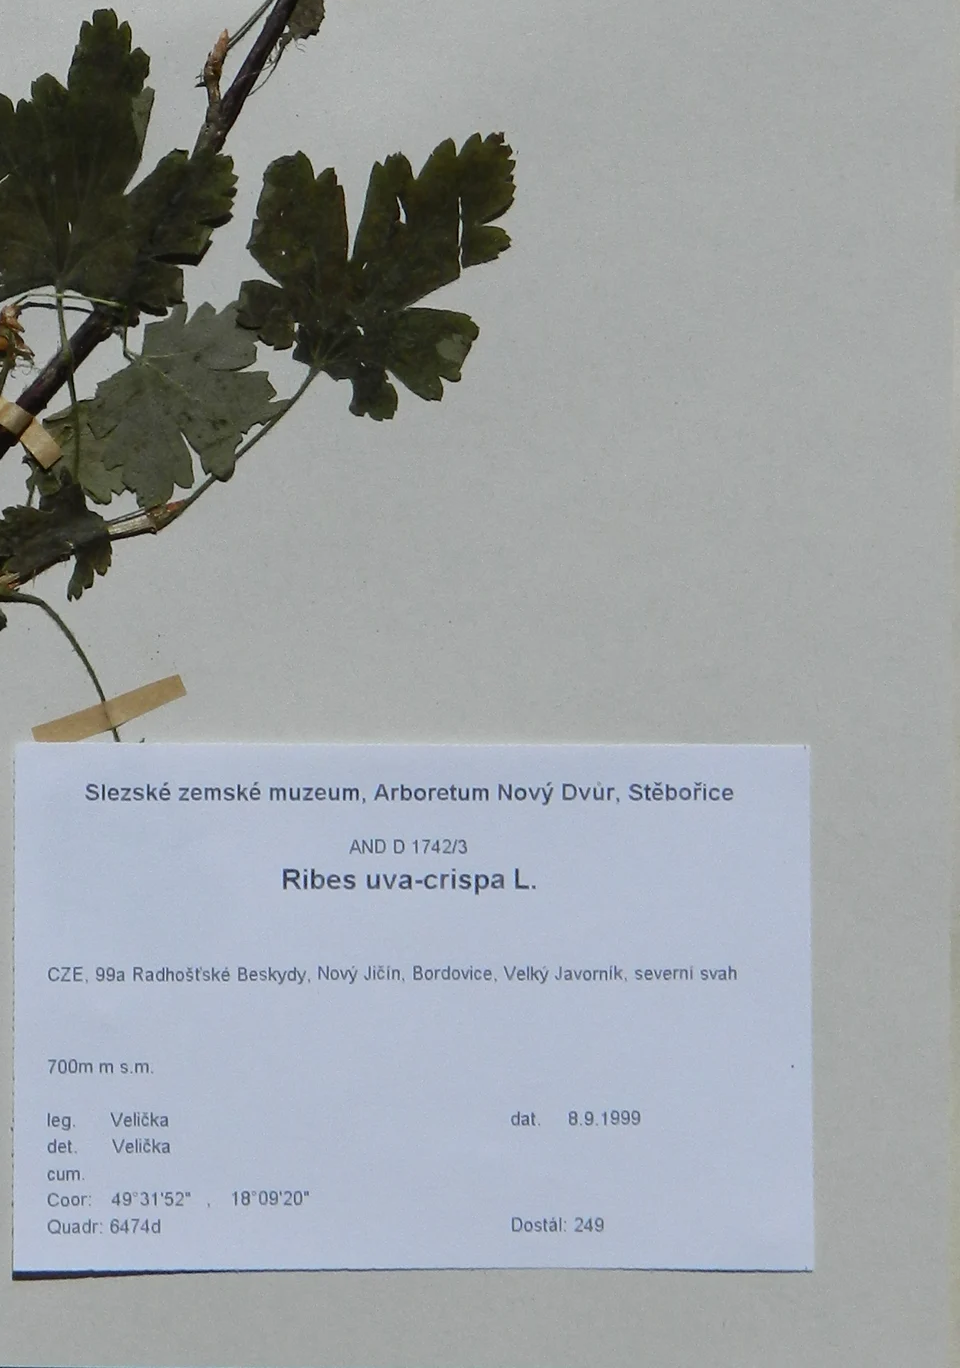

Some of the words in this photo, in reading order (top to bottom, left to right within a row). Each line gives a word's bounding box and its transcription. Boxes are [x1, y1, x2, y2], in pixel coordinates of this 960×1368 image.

[84, 781, 172, 802] Slezské
[178, 781, 262, 802] zemské
[269, 786, 367, 805] muzeum,
[373, 783, 490, 802] Arboretum
[497, 779, 555, 807] Nový
[561, 780, 621, 805] Dvůr,
[627, 781, 735, 802] Stěbořice
[348, 838, 387, 855] AND
[393, 838, 406, 855] D
[412, 838, 468, 855] 1742/3
[282, 867, 357, 891] Ribes
[366, 867, 505, 896] uva-crispa
[514, 867, 537, 890] L.
[47, 966, 89, 984] CZE,
[95, 966, 126, 983] 99a
[132, 966, 231, 983] Radhošťské
[237, 966, 311, 986] Beskydy,
[317, 964, 359, 985] Nový
[363, 964, 406, 983] Jičín,
[412, 964, 498, 983] Bordovice,
[503, 964, 550, 985] Velký
[554, 964, 628, 983] Javorník,
[634, 964, 694, 982] severní
[699, 964, 738, 982] svah
[47, 1058, 94, 1075] 700m
[98, 1061, 114, 1075] m
[119, 1061, 155, 1075] s.m.
[46, 1112, 77, 1132] leg.
[109, 1111, 170, 1129] Velička
[510, 1110, 542, 1127] dat.
[567, 1109, 642, 1127] 8.9.1999
[46, 1137, 79, 1155] det.
[111, 1137, 172, 1155] Velička
[46, 1167, 86, 1182] cum.
[46, 1191, 93, 1208] Coor:
[46, 1218, 104, 1236] Quadr:
[109, 1217, 162, 1235] 6474d
[510, 1216, 568, 1233] Dostál:
[573, 1216, 605, 1234] 249
